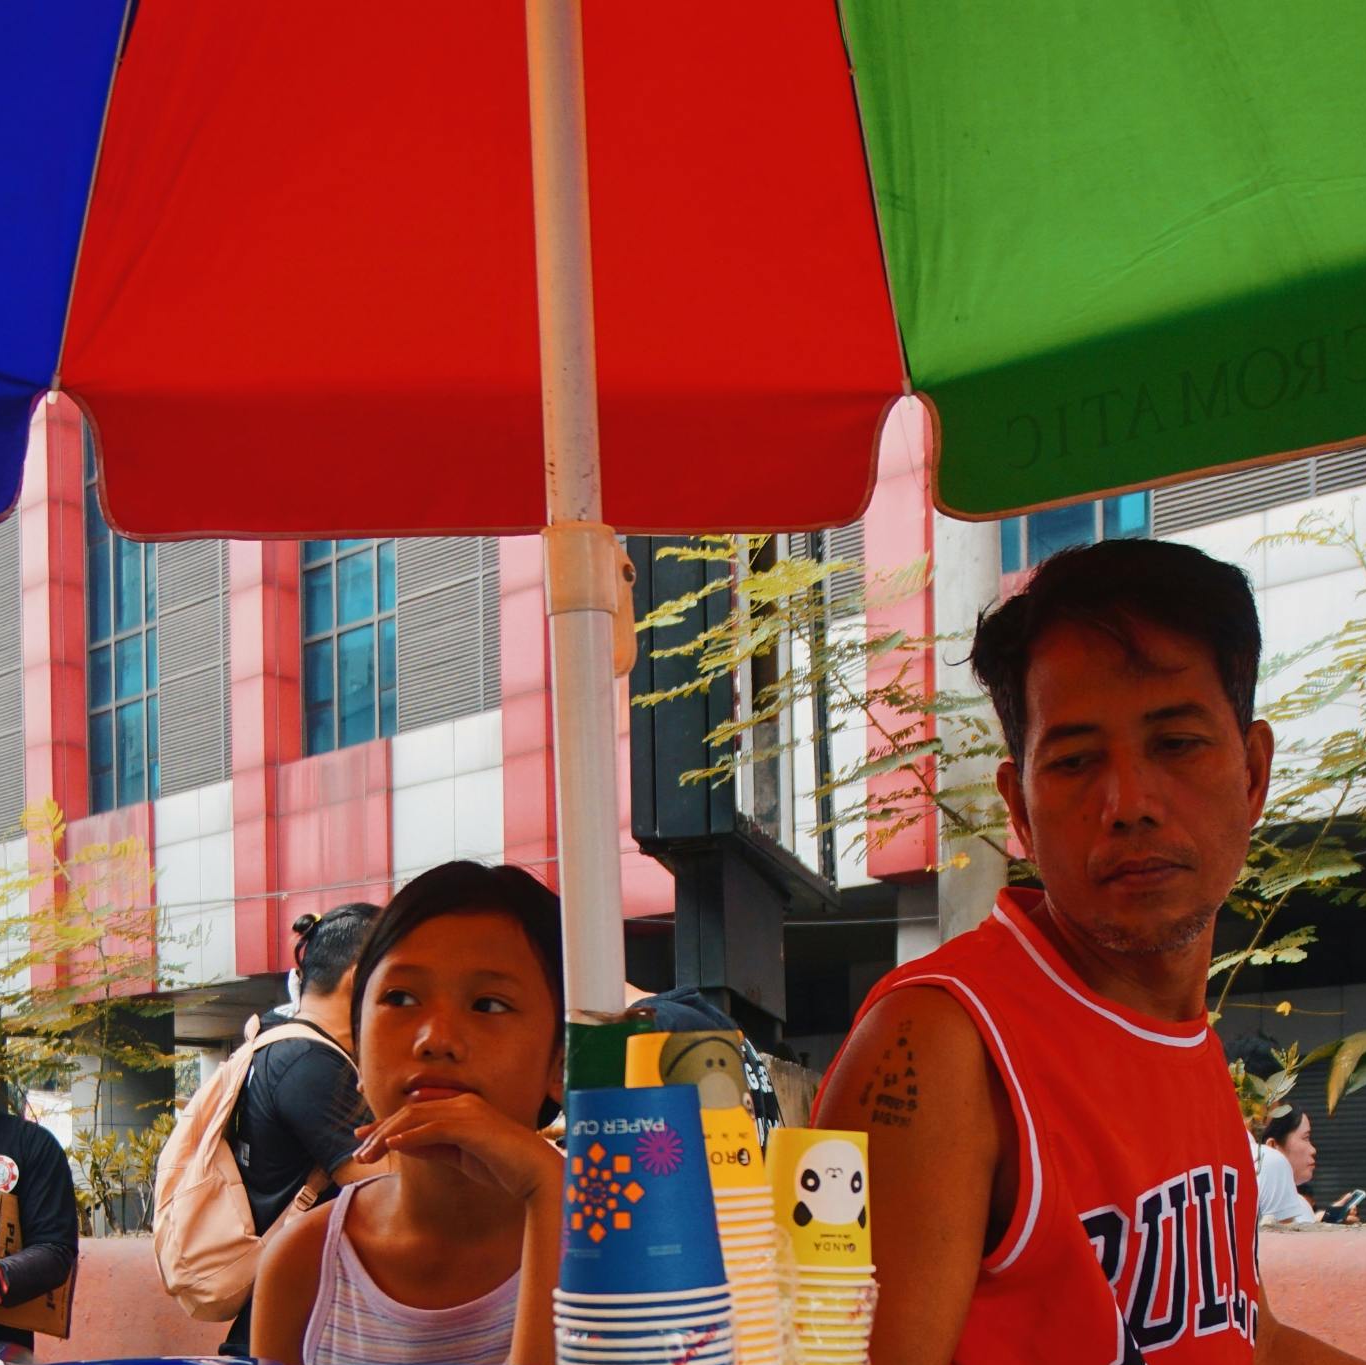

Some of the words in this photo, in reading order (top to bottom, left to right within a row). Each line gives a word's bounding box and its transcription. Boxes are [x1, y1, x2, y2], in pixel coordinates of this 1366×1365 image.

[572, 1119, 600, 1136] CUP
[602, 1118, 666, 1136] PAPER
[710, 1148, 751, 1166] FRO
[813, 1241, 857, 1254] PANDA
